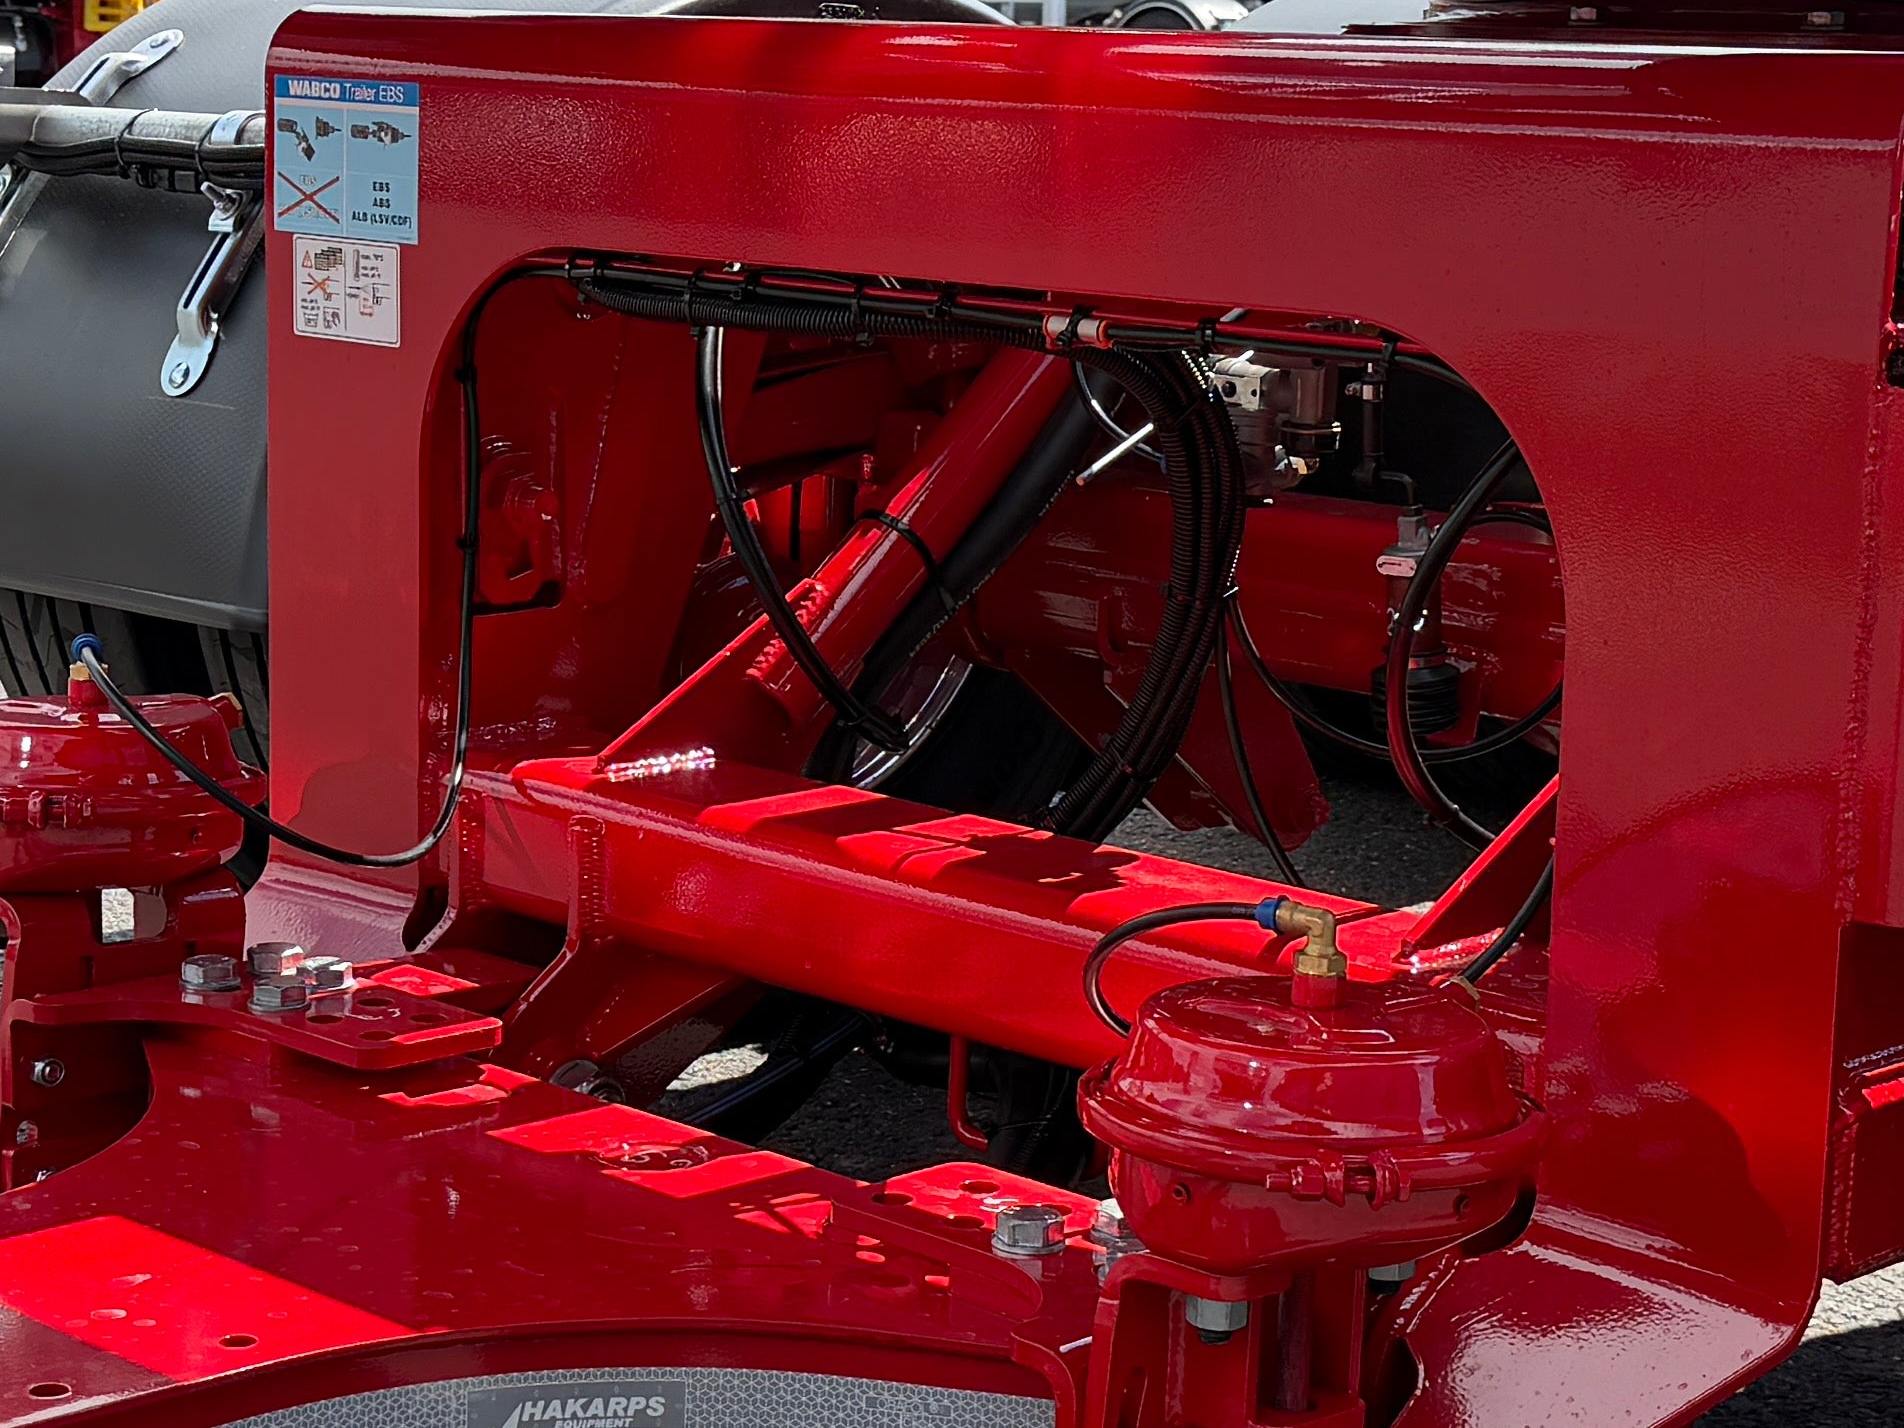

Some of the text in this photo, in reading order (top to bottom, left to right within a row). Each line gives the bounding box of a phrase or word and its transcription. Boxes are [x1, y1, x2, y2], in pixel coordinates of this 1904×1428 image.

[288, 79, 404, 103] WABCO Trailer EBS
[372, 181, 390, 193] EBS
[521, 1396, 666, 1422] HAKARPS
